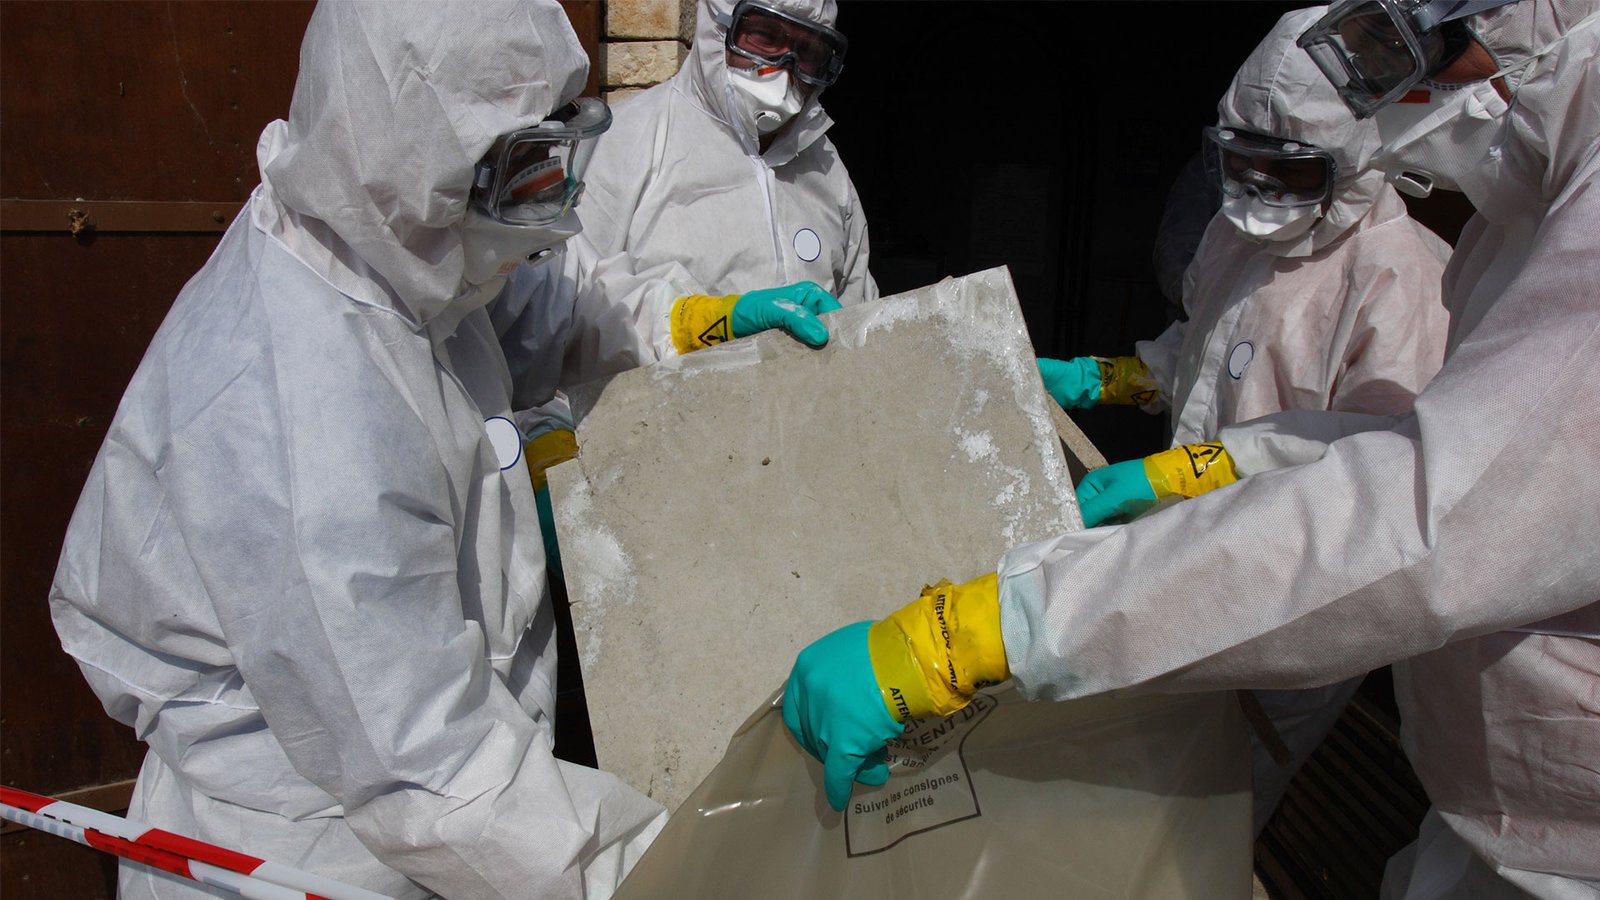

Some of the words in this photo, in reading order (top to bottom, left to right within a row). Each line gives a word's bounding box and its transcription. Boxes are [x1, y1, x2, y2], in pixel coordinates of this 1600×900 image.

[961, 696, 989, 721] DE
[854, 799, 889, 815] Suivre
[890, 791, 902, 804] les
[903, 772, 960, 797] consignes
[885, 811, 895, 825] de
[895, 795, 935, 819] sécurité
